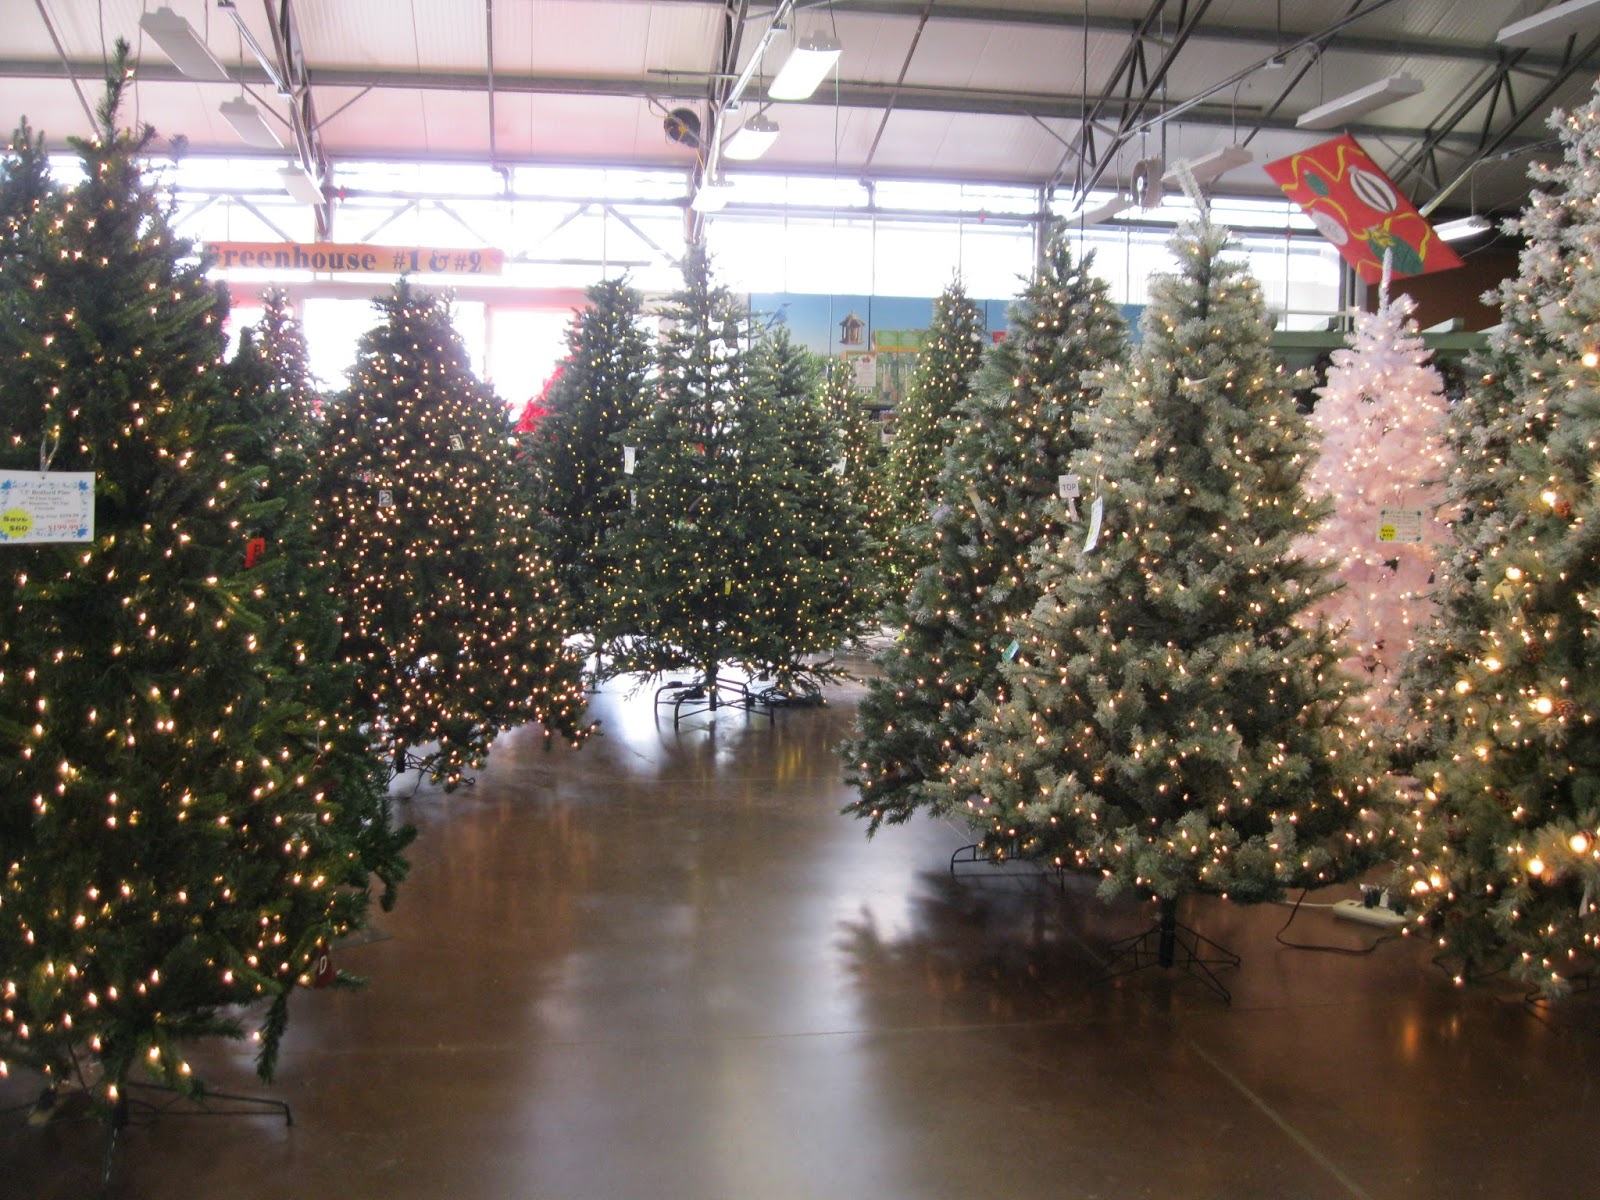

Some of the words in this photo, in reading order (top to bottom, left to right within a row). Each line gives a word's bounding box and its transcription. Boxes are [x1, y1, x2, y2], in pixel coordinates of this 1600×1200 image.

[392, 249, 420, 272] #1
[429, 249, 450, 272] &
[454, 250, 482, 273] #2
[9, 524, 28, 532] $60
[47, 524, 79, 532] $199.99
